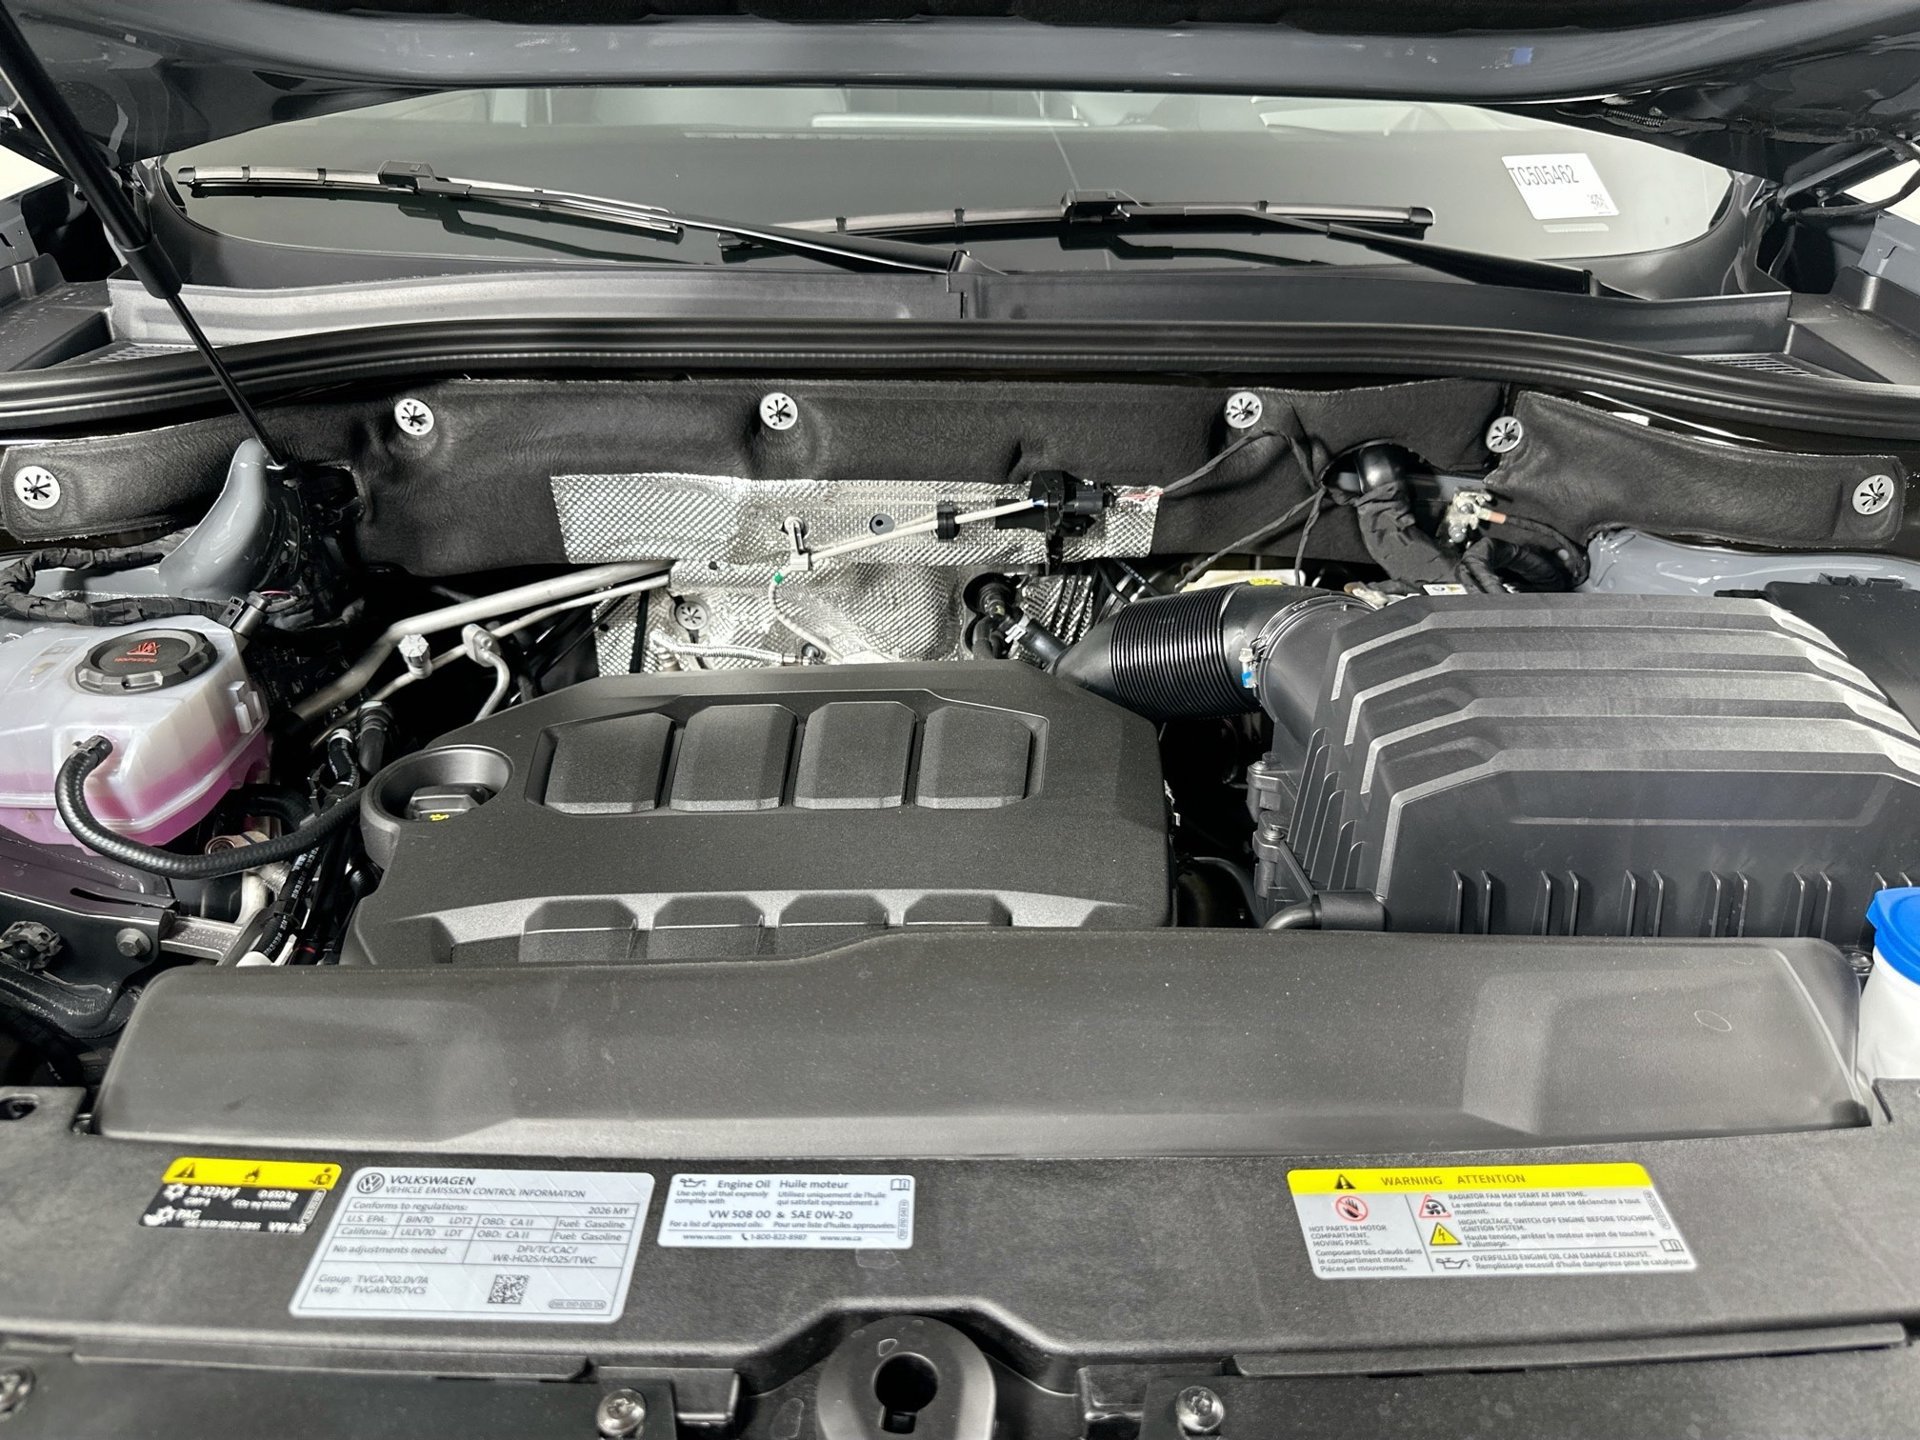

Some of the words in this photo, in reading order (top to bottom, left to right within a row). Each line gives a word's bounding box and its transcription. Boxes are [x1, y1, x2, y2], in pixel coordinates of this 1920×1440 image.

[1507, 164, 1579, 186] TC505462
[391, 1175, 475, 1185] VOLKSWAGEN
[718, 1180, 753, 1190] Engine
[755, 1180, 771, 1188] Oil
[780, 1180, 807, 1188] Huile
[1381, 1176, 1443, 1186] WARNING
[1458, 1174, 1526, 1184] ATTENTION
[425, 1187, 472, 1195] EMISSION
[473, 1188, 516, 1196] CONTROL
[519, 1189, 586, 1198] INFORMATION
[412, 1203, 468, 1211] regulations:
[614, 1207, 629, 1215] MY
[1549, 1200, 1566, 1208] peut
[175, 1209, 201, 1219] PAG
[709, 1210, 730, 1218] VW
[732, 1210, 753, 1218] 508
[755, 1210, 771, 1218] 00
[791, 1210, 813, 1218] SAE
[815, 1211, 853, 1219] 0W-20
[405, 1216, 433, 1224] BIN70
[482, 1218, 506, 1226] OBD:
[558, 1220, 581, 1228] Fuel:
[268, 1222, 289, 1232] VW
[290, 1224, 306, 1233] AG
[444, 1229, 463, 1237] LDT
[554, 1232, 577, 1240] Fuel:
[581, 1233, 622, 1241] Gasoline
[333, 1245, 347, 1253] No
[349, 1246, 409, 1255] adjustments
[411, 1246, 448, 1255] needed
[1316, 1249, 1362, 1257] Composants
[1318, 1257, 1325, 1265] le
[1327, 1257, 1381, 1265] compartiment
[1472, 1254, 1521, 1262] OVERFILLED
[1476, 1262, 1524, 1270] Remplissage
[1525, 1261, 1555, 1269] excessif
[1555, 1260, 1581, 1268] d'huile
[1582, 1260, 1623, 1268] dangereux
[319, 1275, 351, 1284] Group:
[314, 1286, 340, 1294] Evap:
